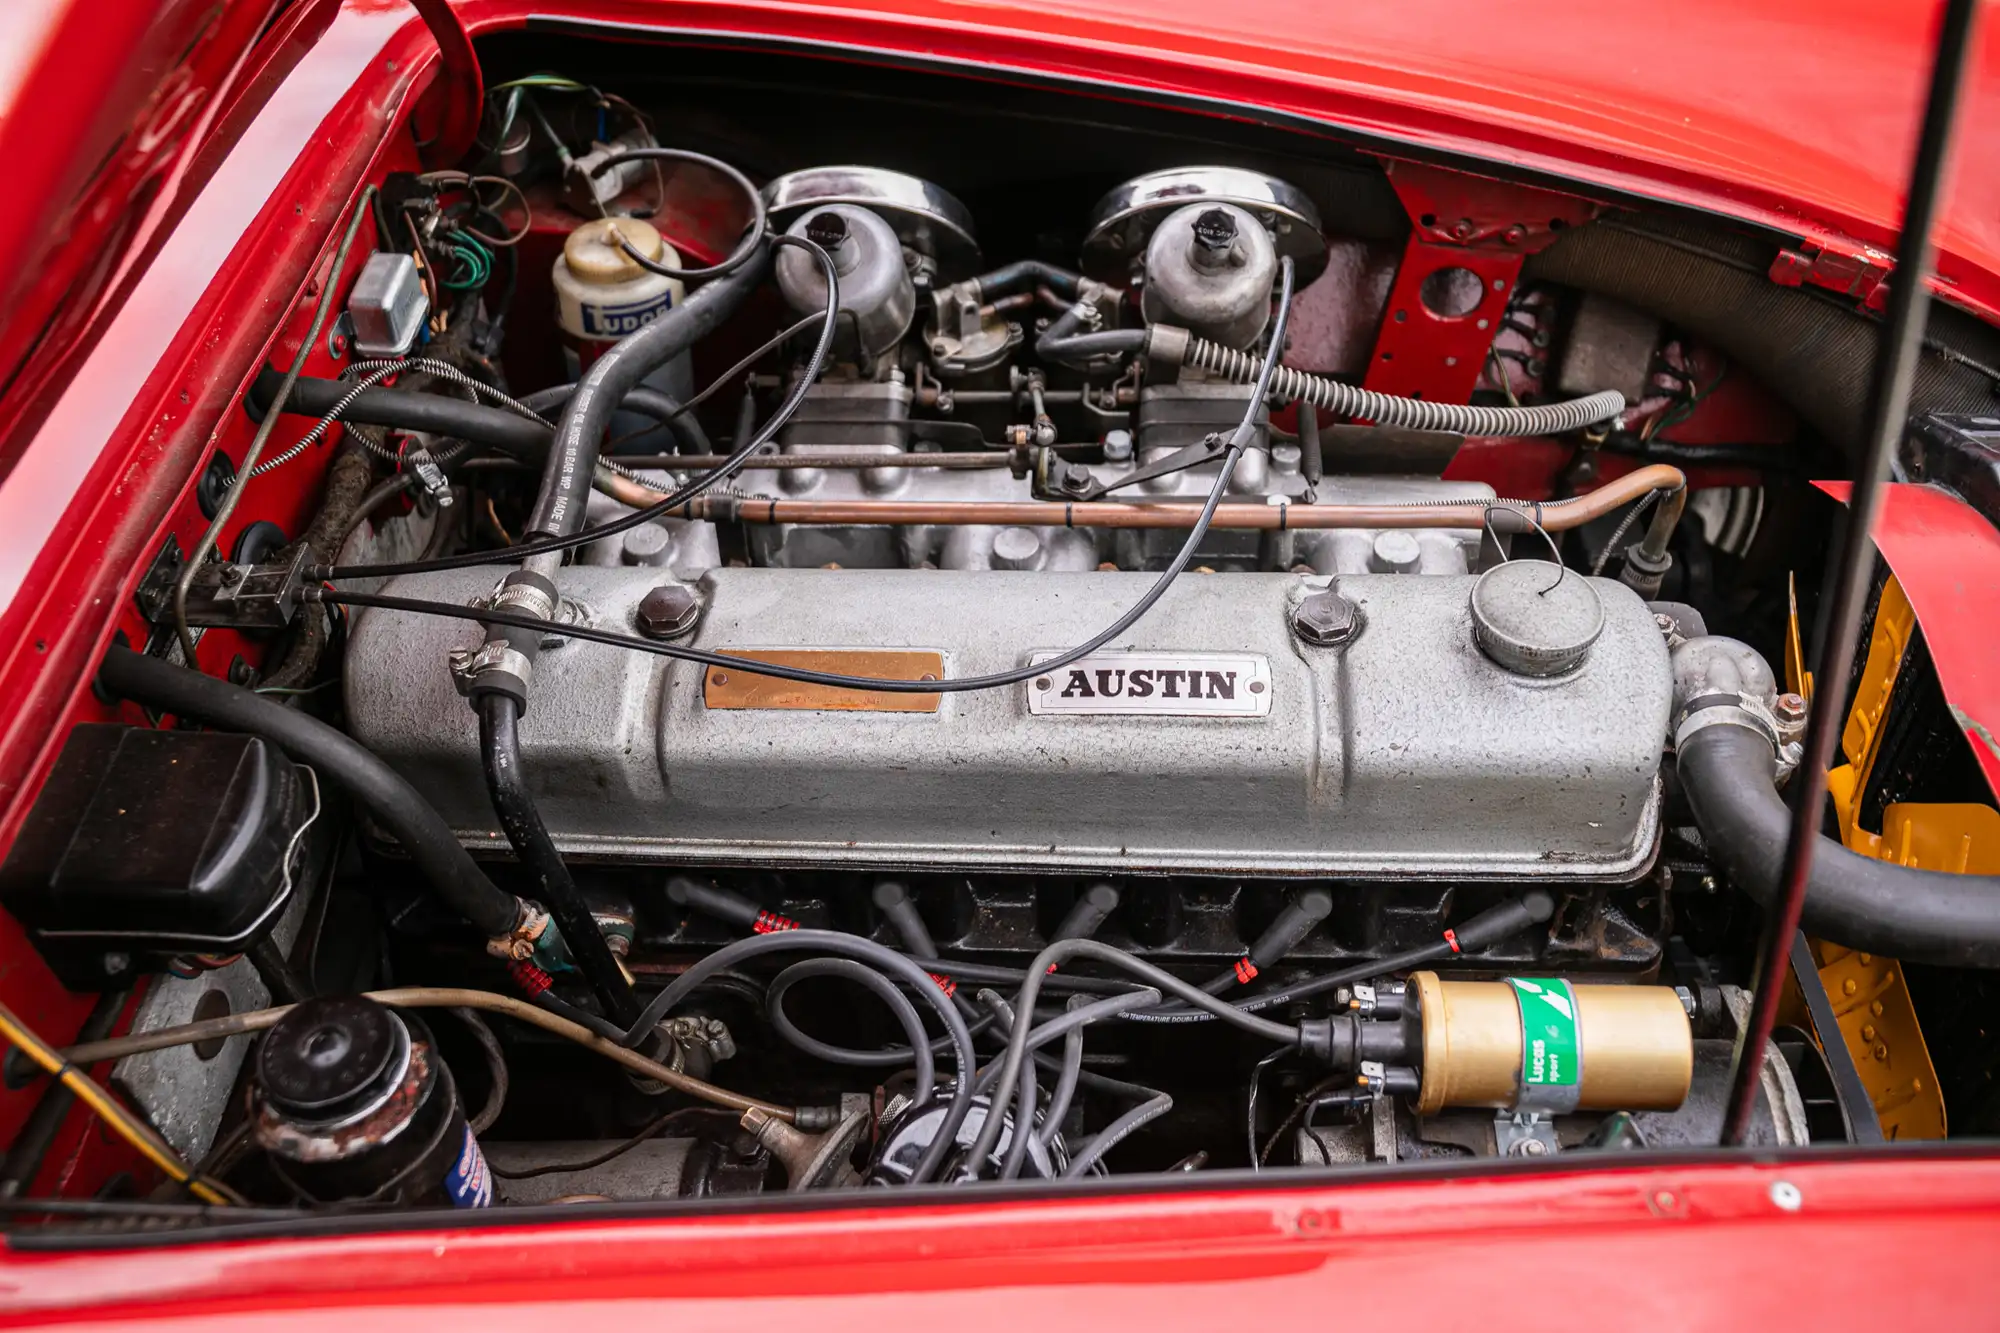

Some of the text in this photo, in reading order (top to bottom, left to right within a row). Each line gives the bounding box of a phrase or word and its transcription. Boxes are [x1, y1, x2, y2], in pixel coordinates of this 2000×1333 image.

[568, 425, 582, 446] HOSE
[566, 448, 577, 456] 10
[562, 456, 576, 473] BAR
[560, 476, 573, 490] WP
[551, 495, 569, 521] MADE
[547, 522, 560, 533] IN
[1060, 669, 1237, 700] AUSTIN
[1171, 1015, 1199, 1024] DOUBLE
[1528, 1040, 1545, 1082] Lucas
[1549, 1053, 1561, 1082] sport
